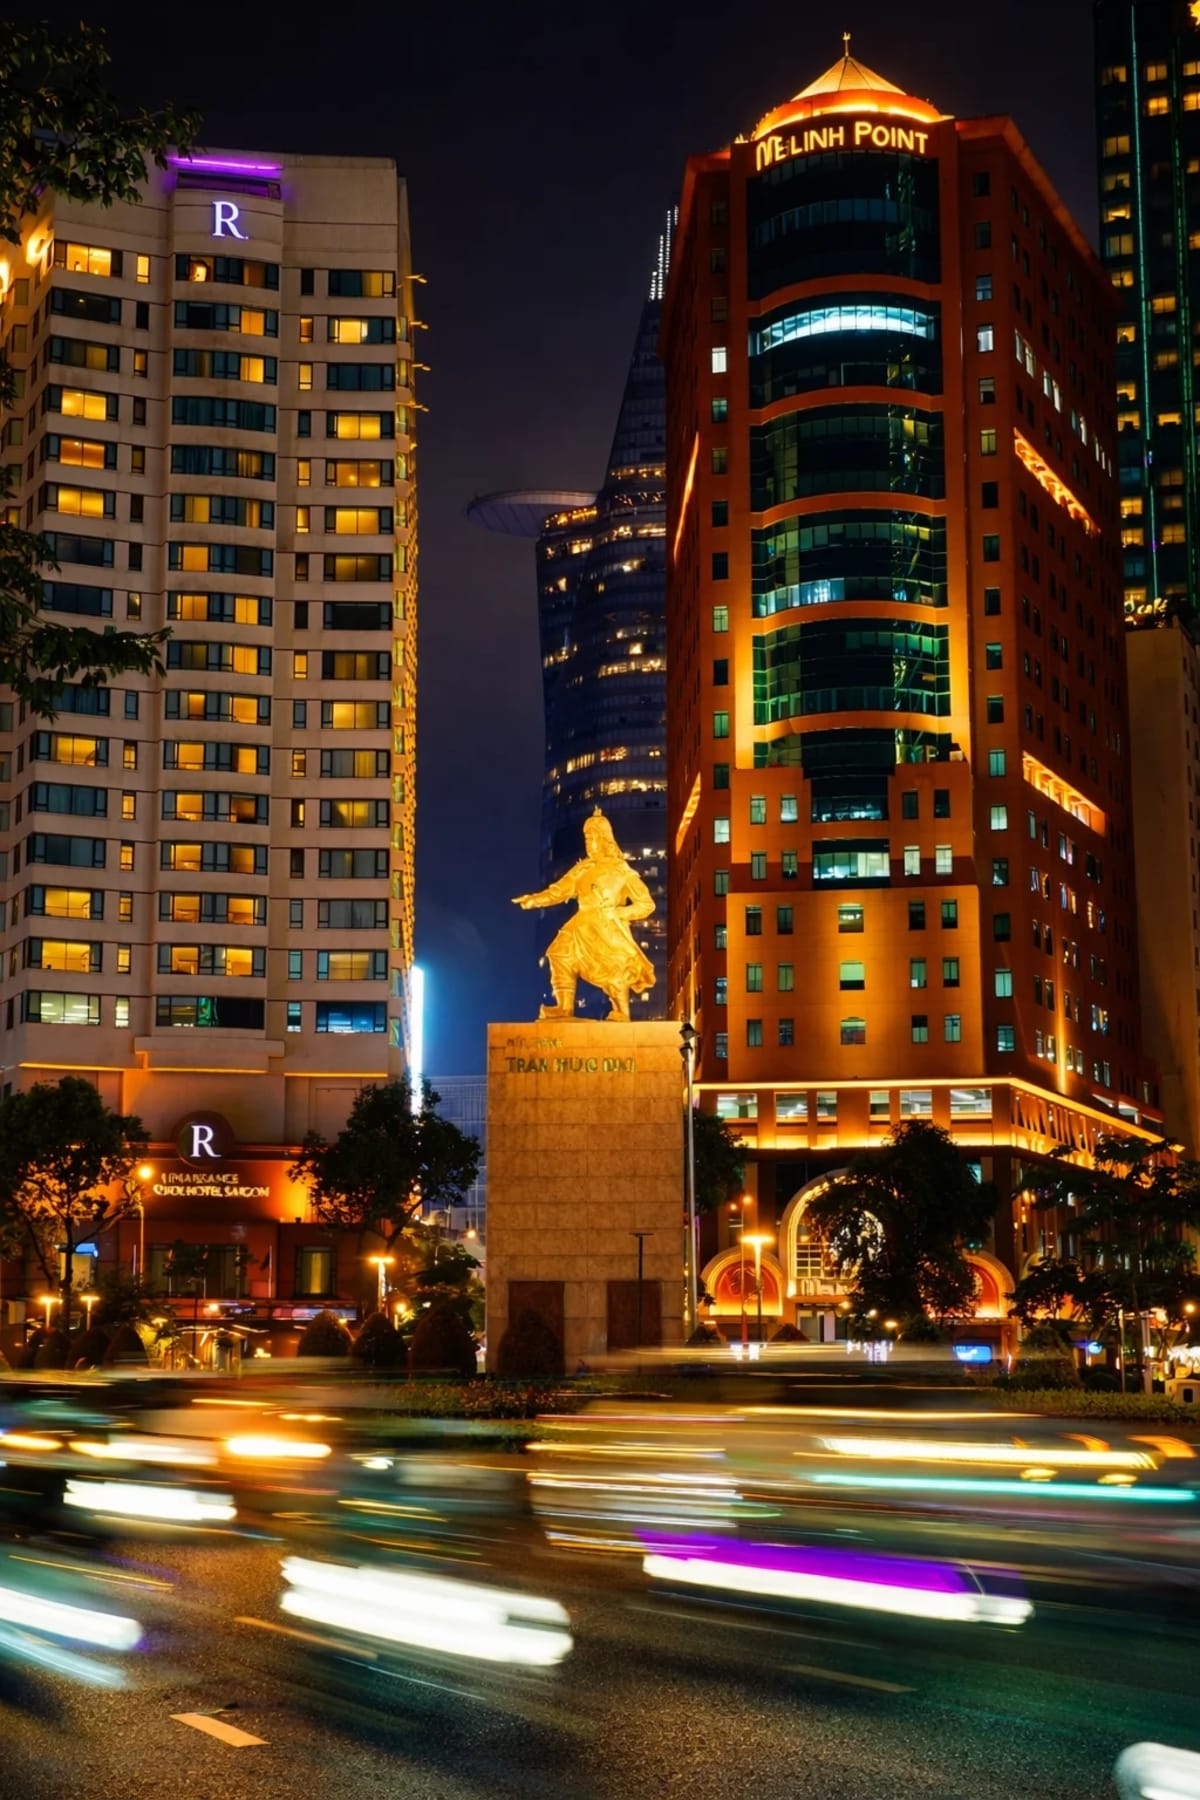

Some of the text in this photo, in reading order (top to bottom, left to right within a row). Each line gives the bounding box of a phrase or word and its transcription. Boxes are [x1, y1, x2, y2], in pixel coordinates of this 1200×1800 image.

[854, 121, 929, 154] POINT
[212, 201, 249, 239] R
[190, 1124, 222, 1158] R
